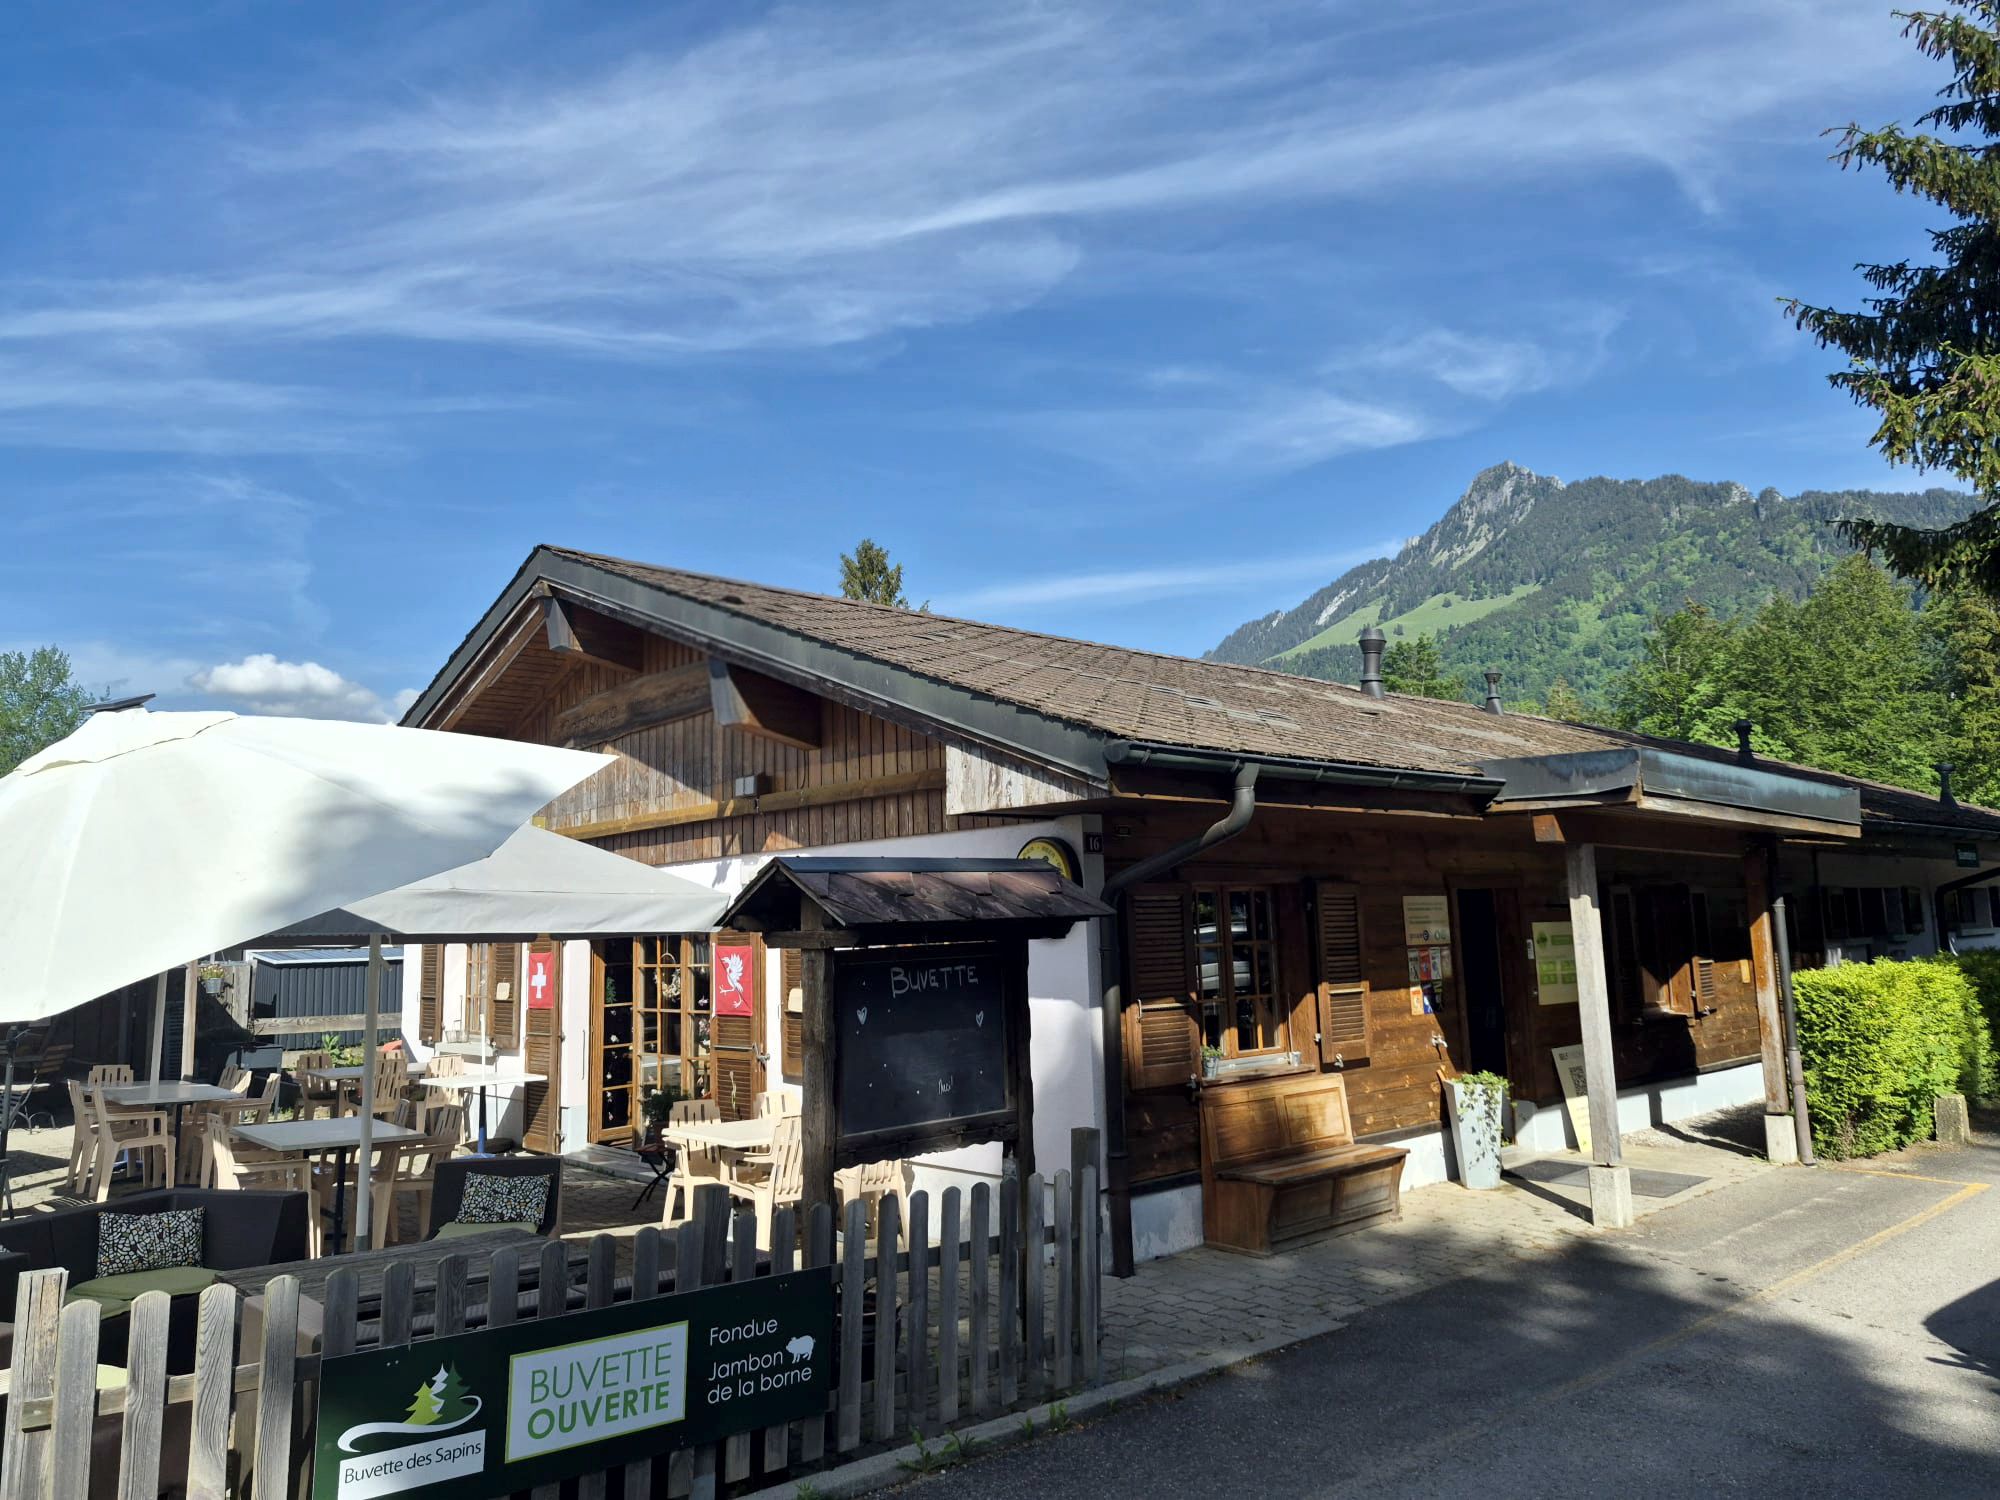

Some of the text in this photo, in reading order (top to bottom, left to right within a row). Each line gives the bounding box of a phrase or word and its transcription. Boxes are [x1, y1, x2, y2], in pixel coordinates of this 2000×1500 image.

[1089, 837, 1099, 850] 16
[709, 1318, 778, 1346] Fondue
[530, 1342, 672, 1404] BUVETTE
[707, 1365, 812, 1405] de la borne
[708, 1350, 783, 1381] Jambon
[527, 1381, 669, 1440] OUVERTE
[344, 1442, 482, 1484] Buvette des Sapins
